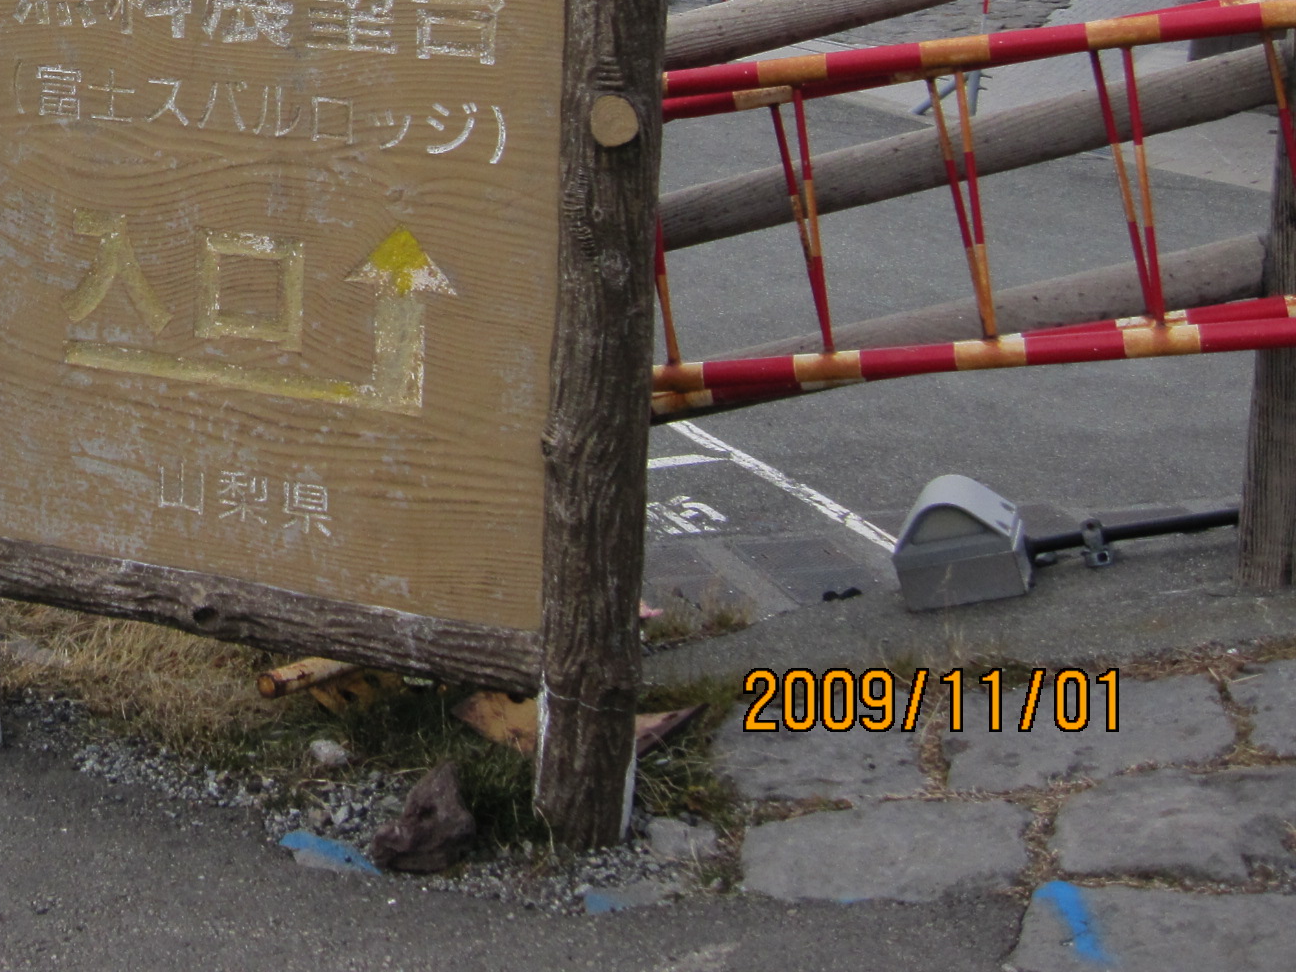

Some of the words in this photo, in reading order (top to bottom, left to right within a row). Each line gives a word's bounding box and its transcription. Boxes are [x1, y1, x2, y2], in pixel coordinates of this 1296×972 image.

[13, 59, 505, 164] (富士スバルロッジ)
[62, 208, 303, 353] 入口
[158, 462, 332, 538] 山梨県
